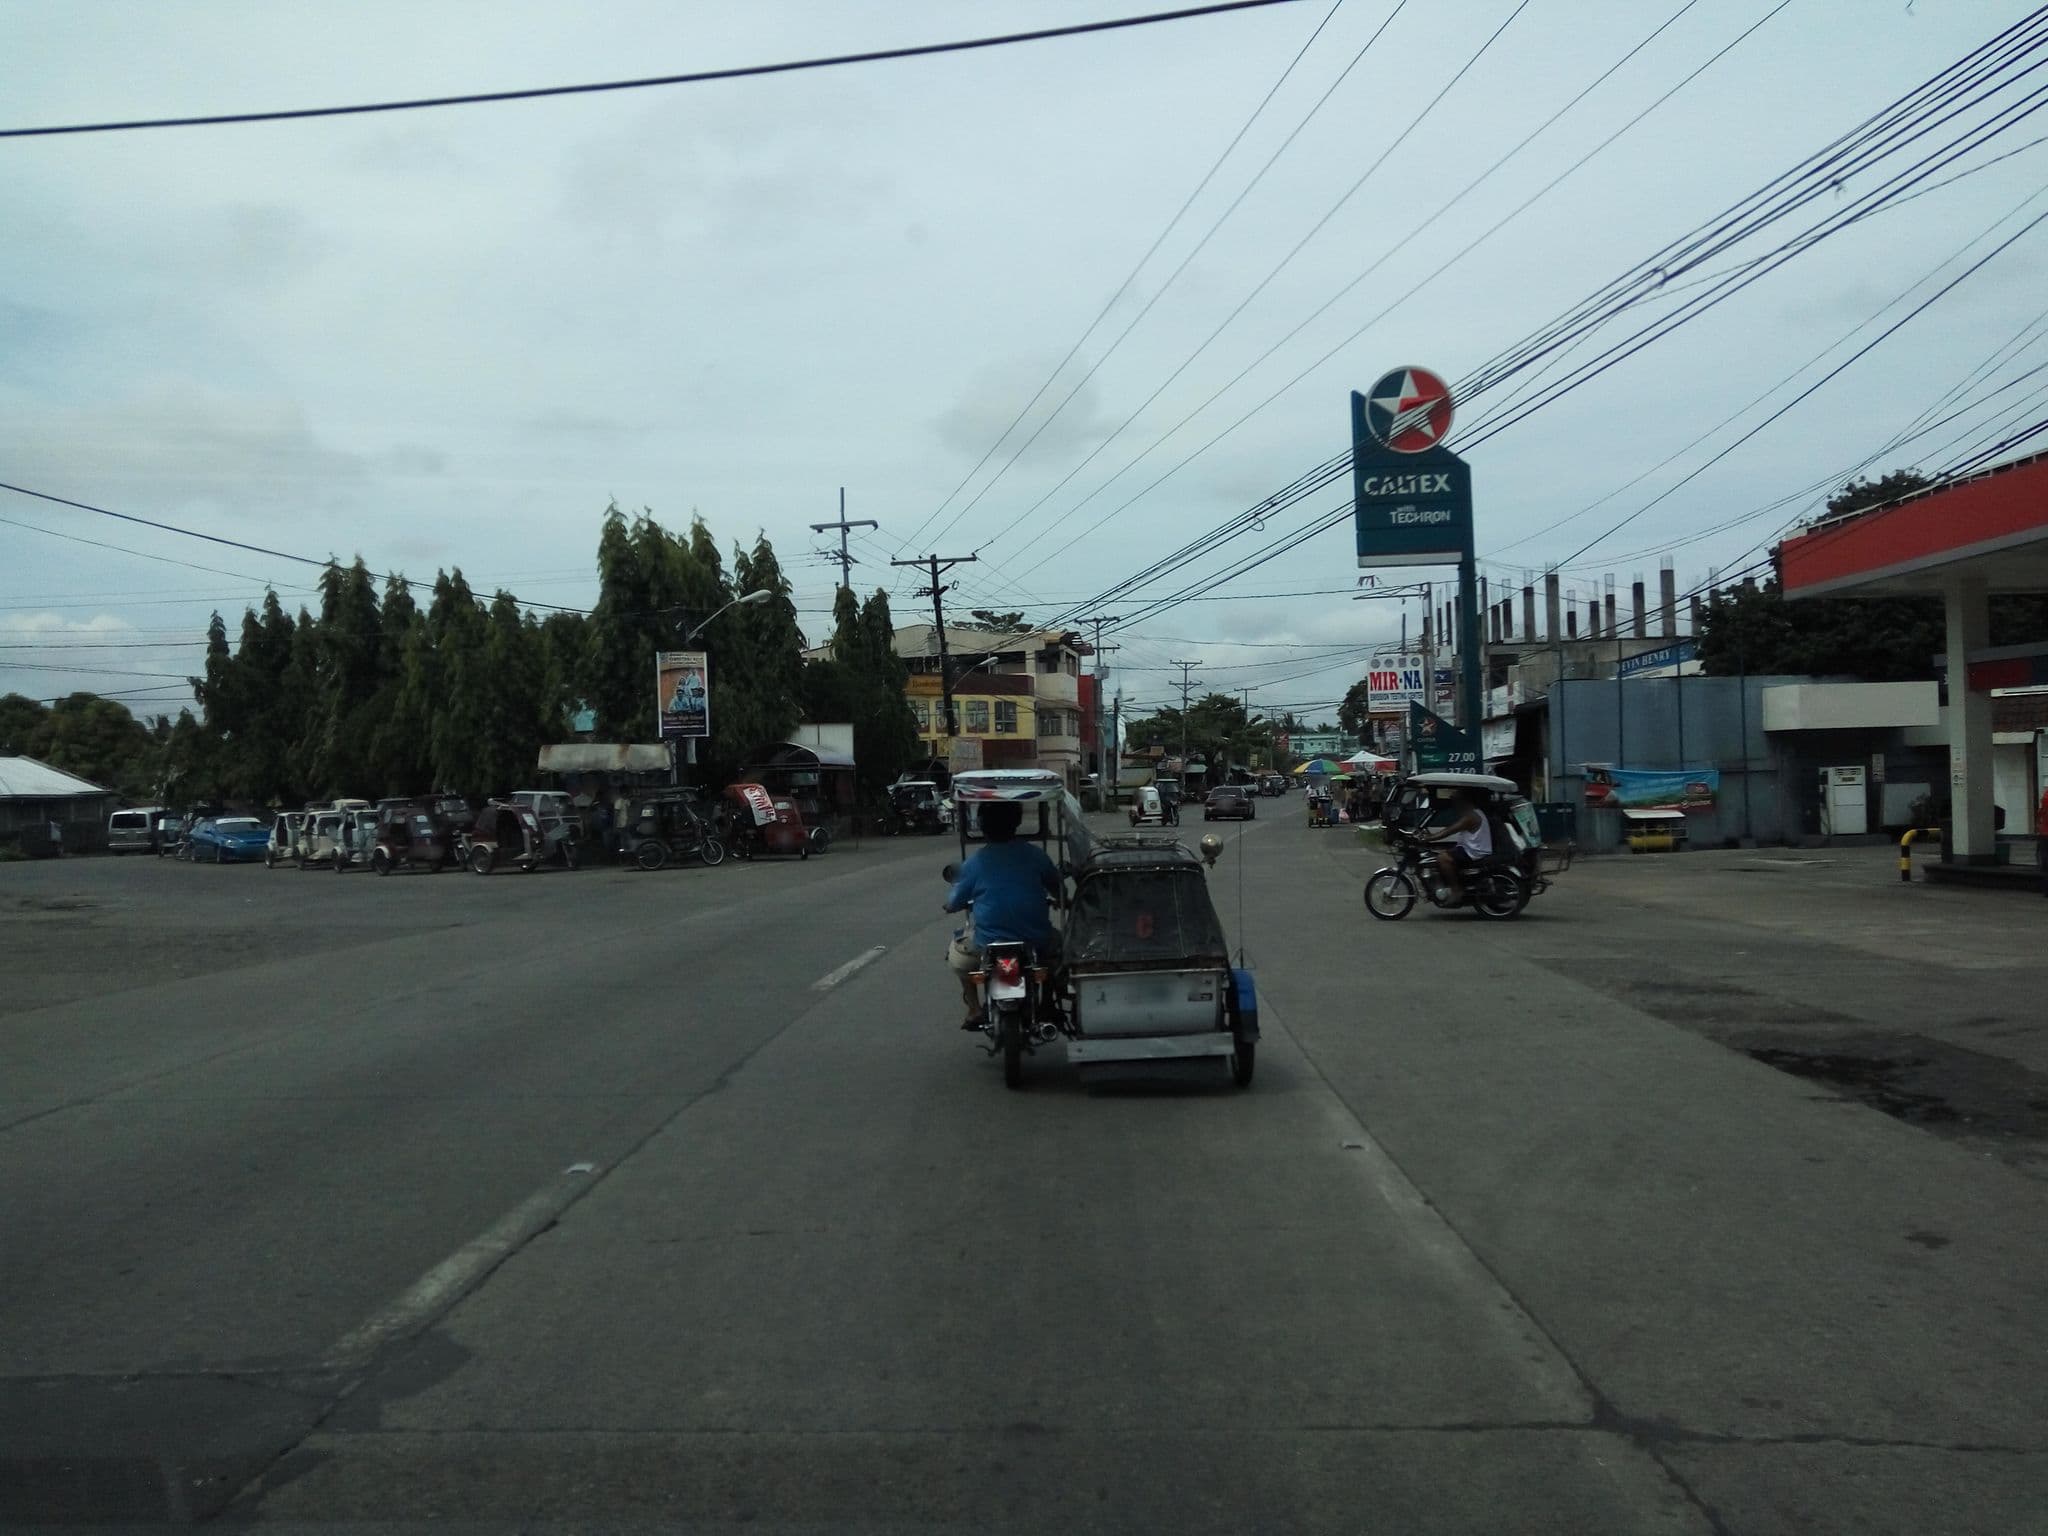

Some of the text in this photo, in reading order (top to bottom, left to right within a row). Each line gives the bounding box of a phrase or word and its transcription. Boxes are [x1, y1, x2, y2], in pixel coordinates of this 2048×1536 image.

[1364, 473, 1451, 496] CALTEX
[1389, 510, 1451, 525] TECHRON
[1448, 752, 1475, 763] 27.00
